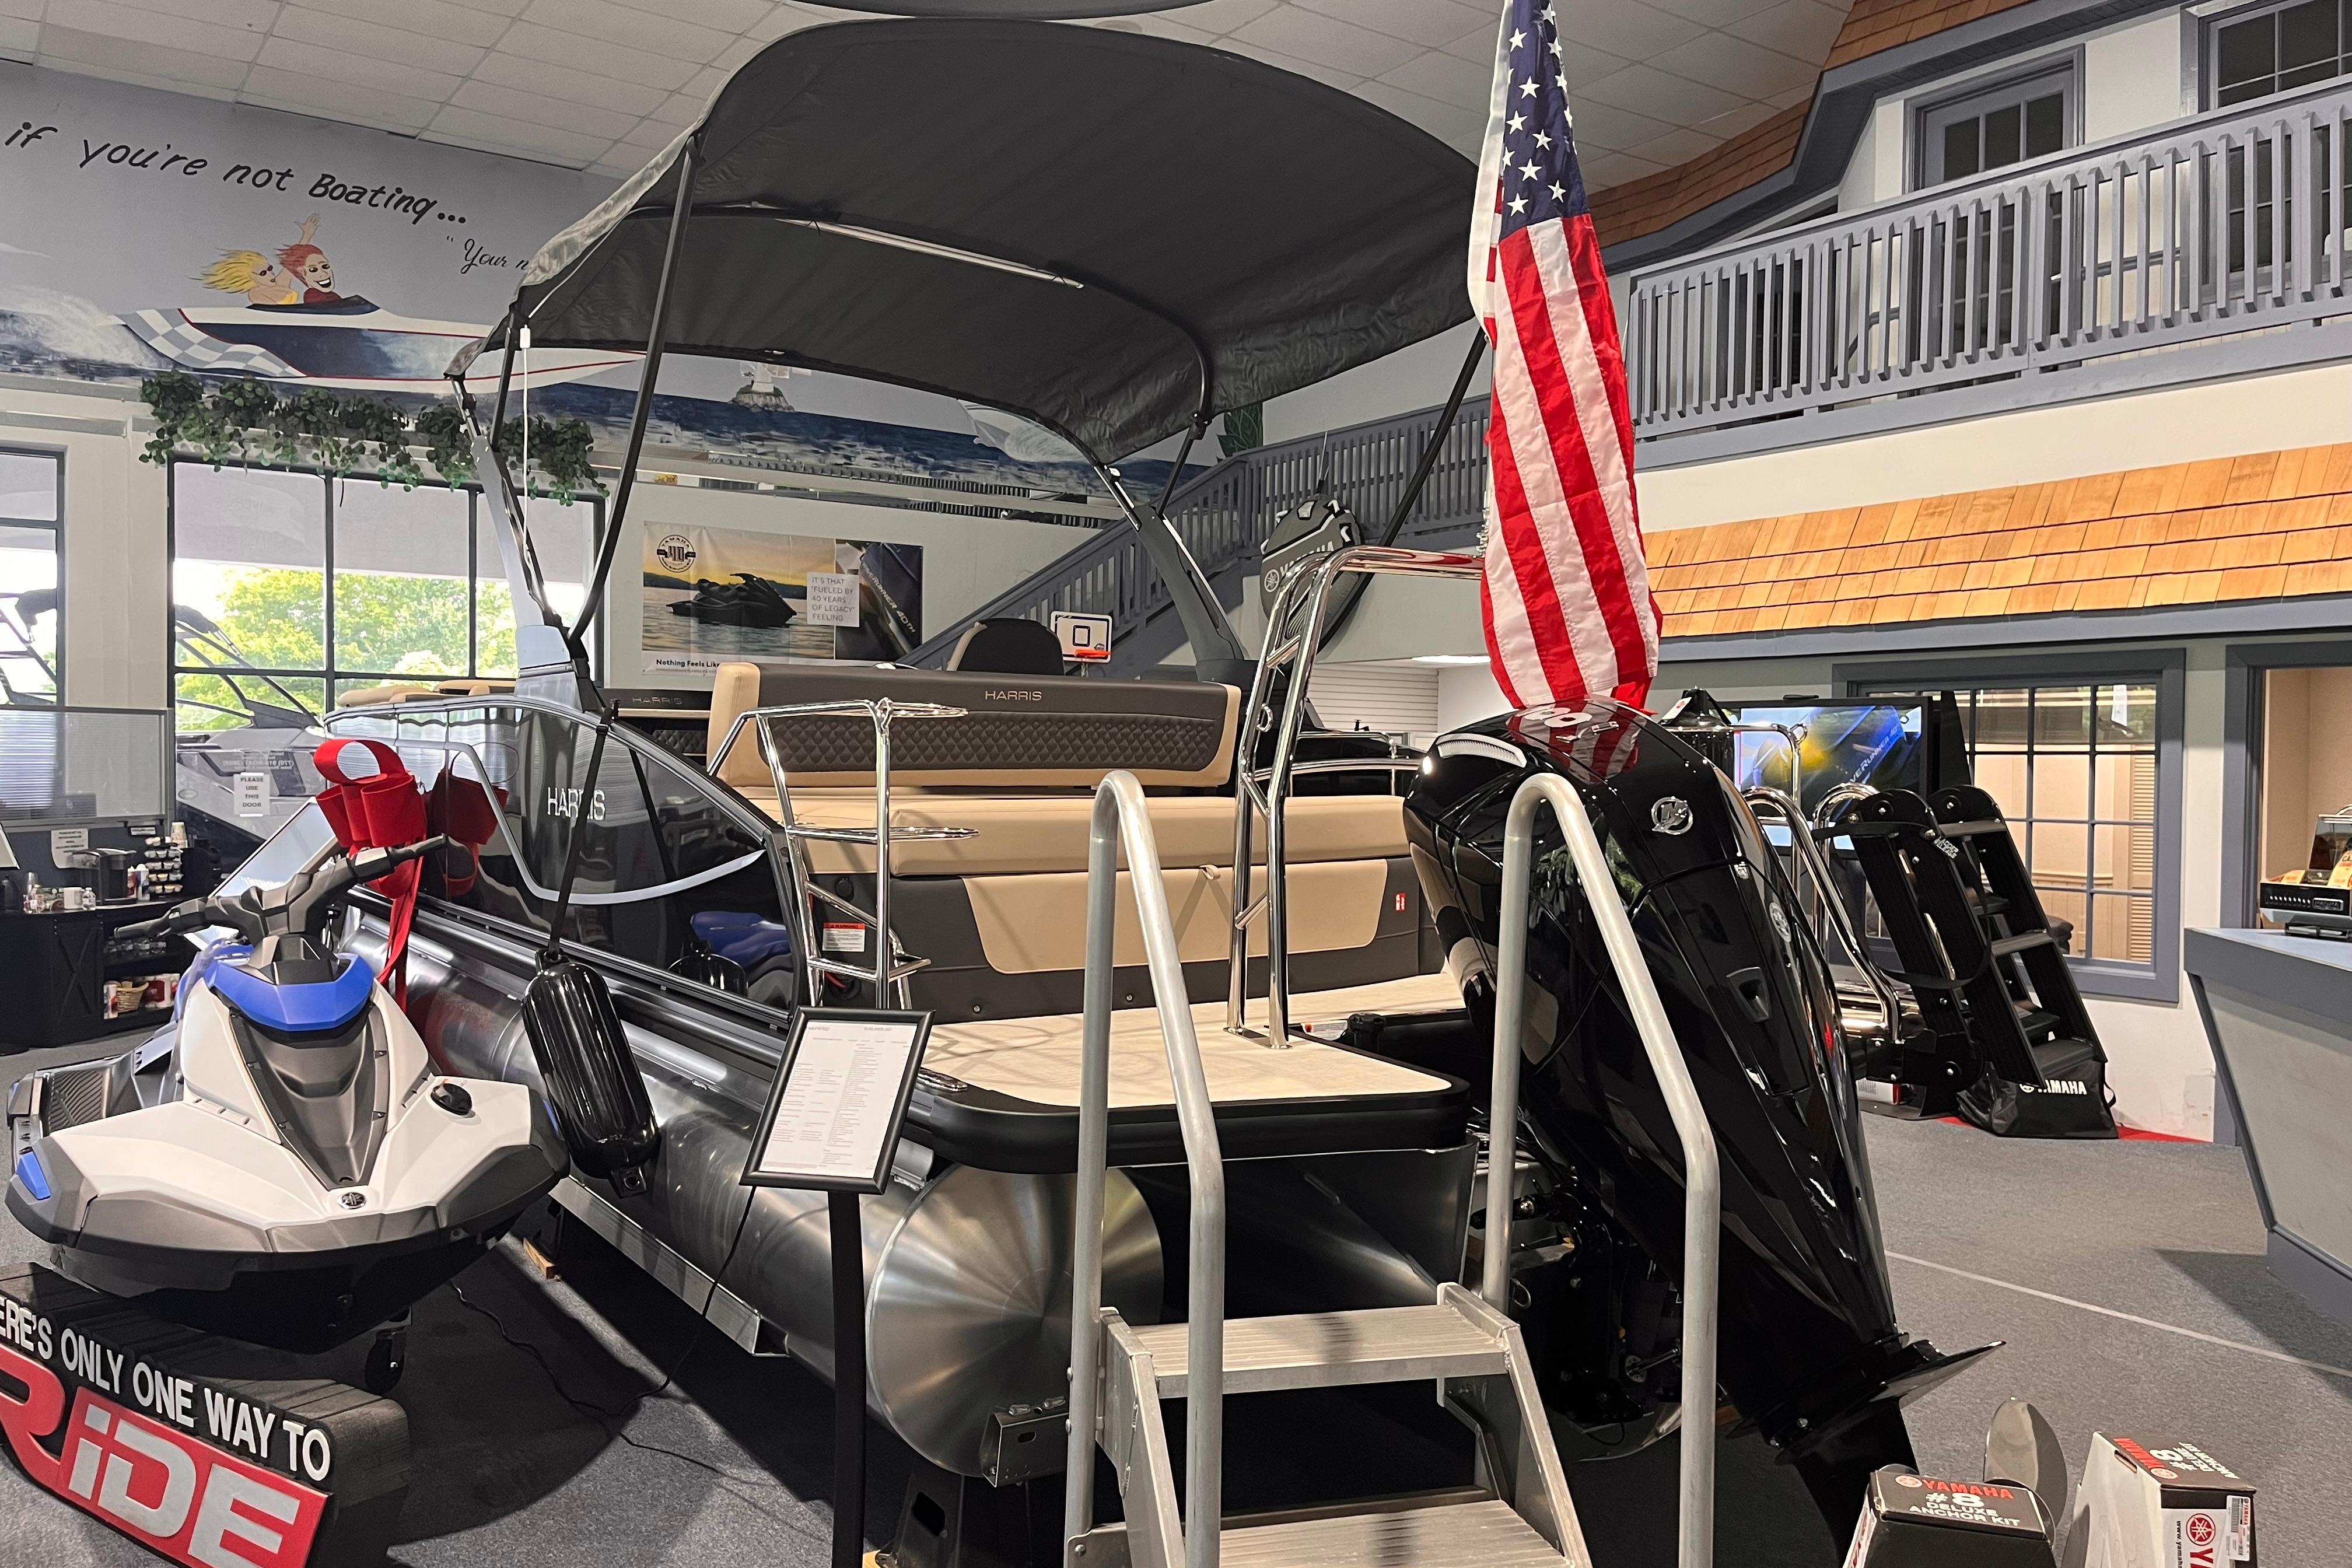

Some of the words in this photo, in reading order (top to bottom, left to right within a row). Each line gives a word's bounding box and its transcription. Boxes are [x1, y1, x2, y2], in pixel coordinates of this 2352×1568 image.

[5, 122, 58, 148] if
[79, 139, 208, 176] you're
[223, 164, 294, 191] not
[813, 613, 844, 621] FEELING
[656, 659, 685, 667] Nothing
[985, 691, 1042, 701] HARRIS
[2038, 1079, 2087, 1095] AMAHA
[61, 1328, 124, 1394] ONLY
[132, 1362, 195, 1427] ONE
[204, 1387, 276, 1458] WAY
[282, 1420, 331, 1481] TO
[1922, 1479, 2014, 1499] YAMAHA
[1909, 1505, 1987, 1522] ANCHOR
[1991, 1516, 2020, 1527] KIT
[1926, 1502, 1999, 1517] DELUXE
